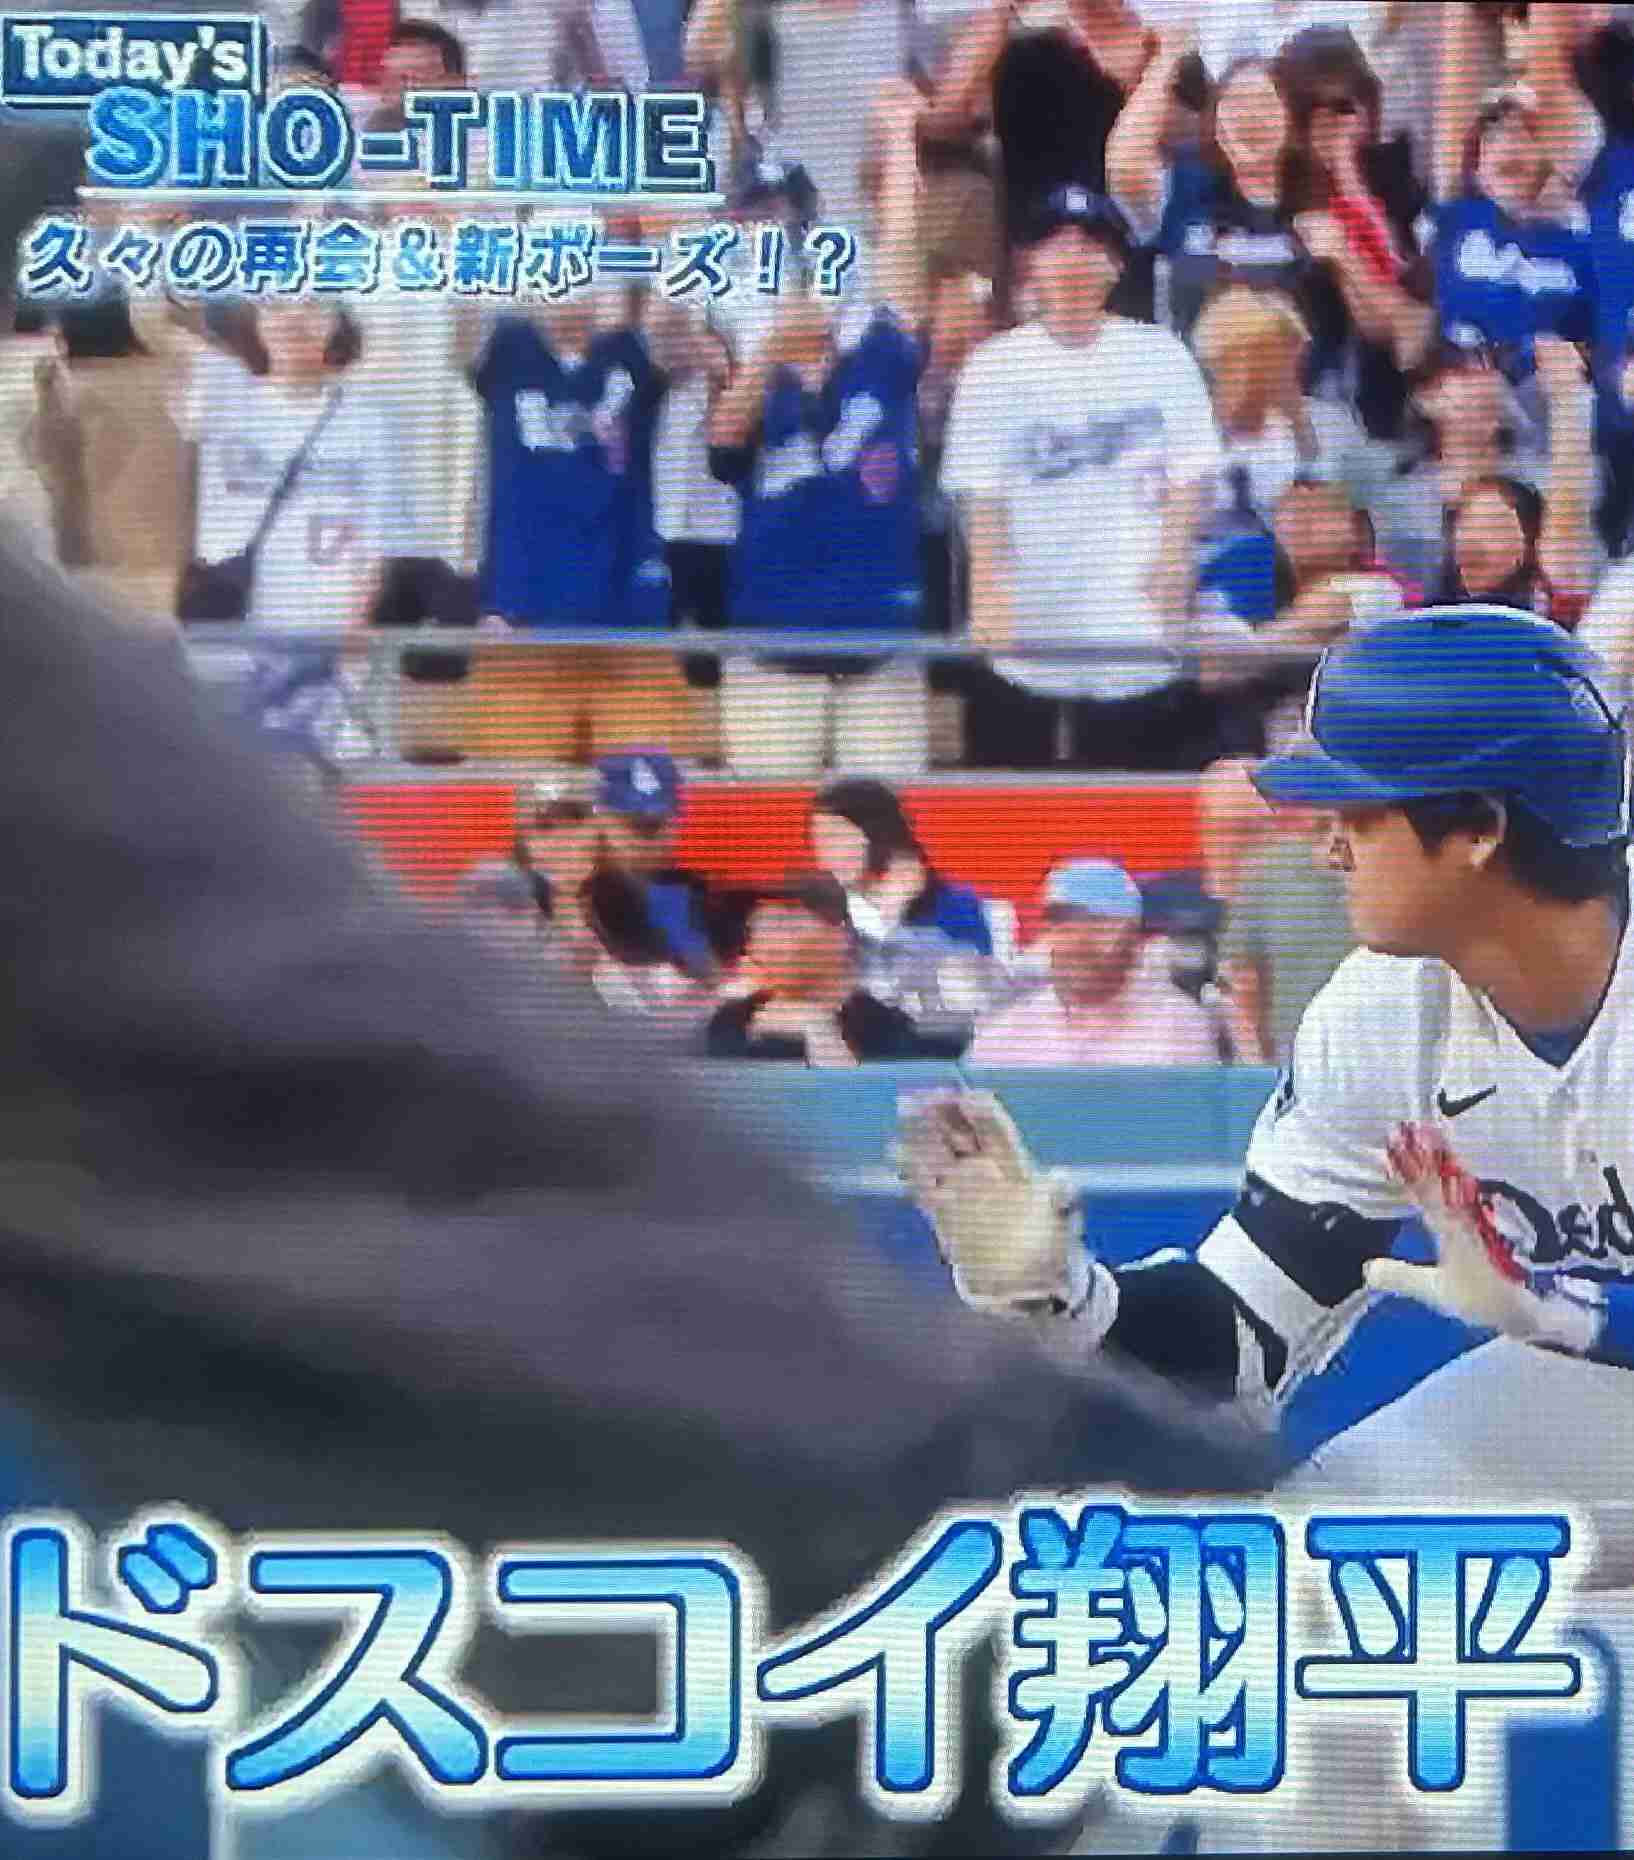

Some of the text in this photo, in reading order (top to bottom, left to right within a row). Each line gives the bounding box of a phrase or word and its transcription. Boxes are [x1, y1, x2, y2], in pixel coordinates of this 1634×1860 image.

[12, 25, 249, 90] Today's
[86, 88, 716, 192] SHO-TIME
[8, 1504, 1582, 1798] ドスコイ翔平
